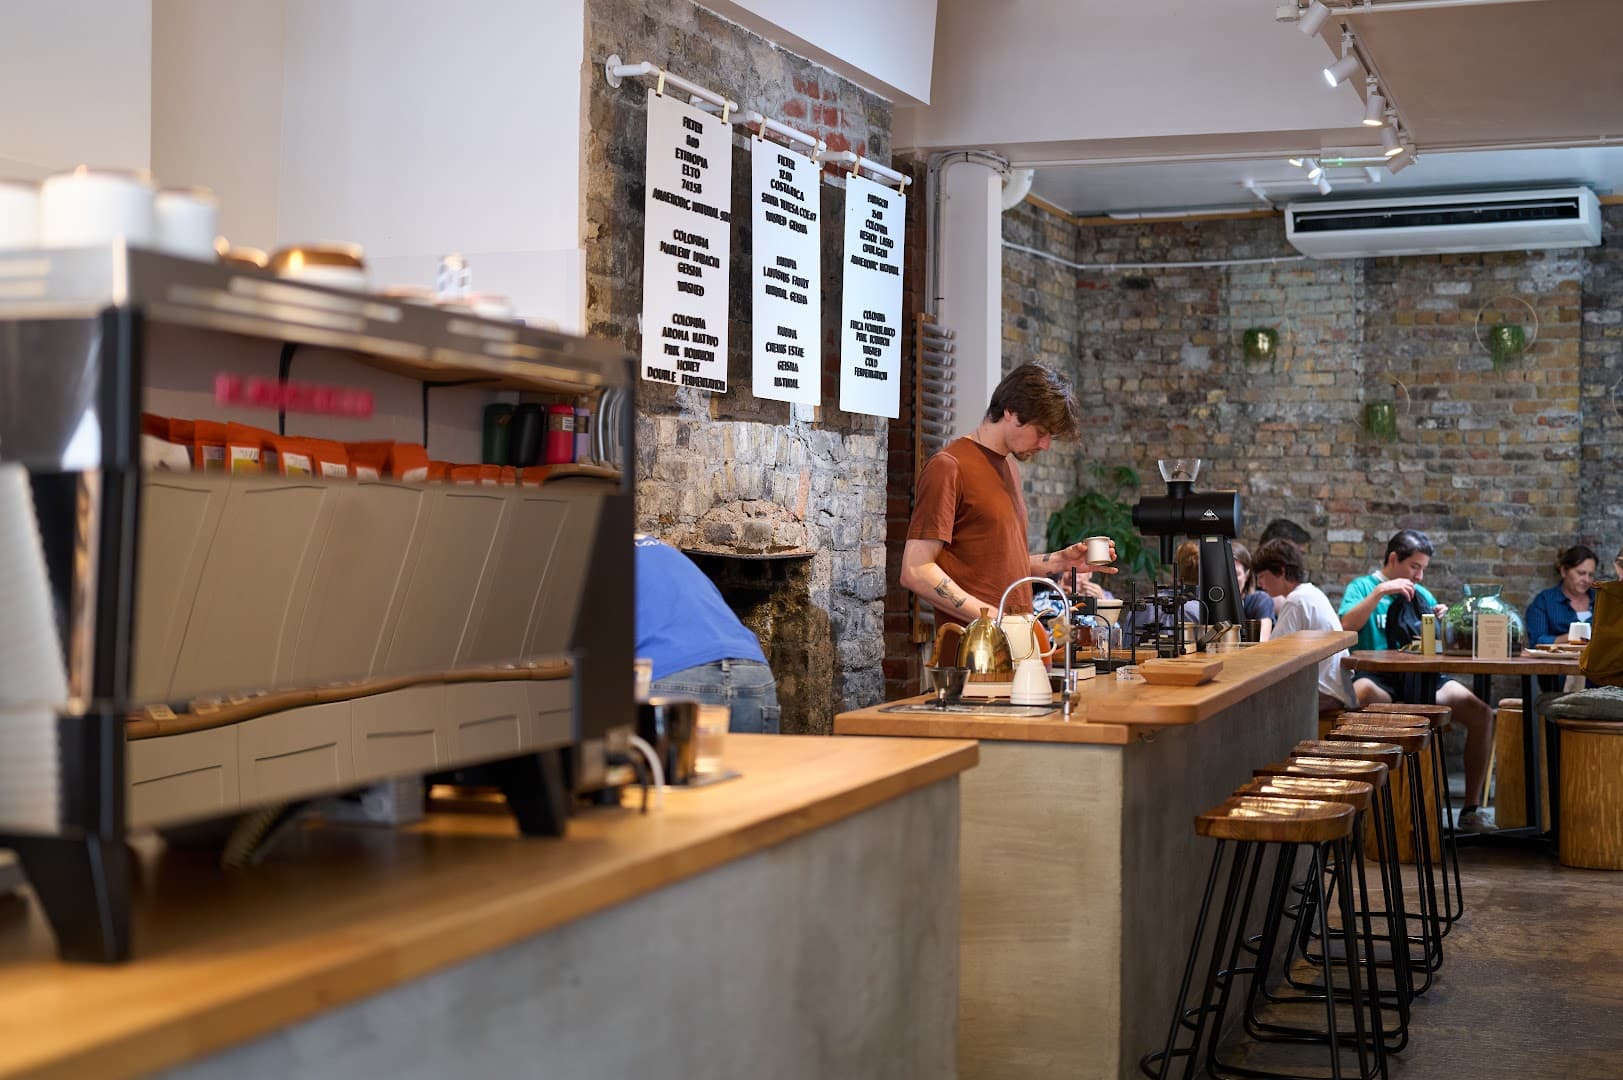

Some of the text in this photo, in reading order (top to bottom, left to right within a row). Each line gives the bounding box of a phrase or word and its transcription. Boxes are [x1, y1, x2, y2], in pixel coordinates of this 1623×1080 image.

[683, 116, 703, 134] FILTER
[675, 147, 708, 169] ETHIOPIA
[778, 154, 795, 170] FILTER
[682, 163, 700, 179] ELTO
[652, 188, 691, 210] ANAEROBIC
[692, 201, 720, 219] NATURAL
[766, 211, 808, 234] WASHED GEISHA
[866, 219, 887, 235] COLOMBIA
[673, 229, 709, 249] COLOMBIA
[677, 262, 702, 278] GEISHA
[677, 281, 704, 296] WASHED
[672, 313, 706, 329] COLOMBIA
[863, 310, 885, 322] COLOMBIA
[662, 326, 719, 347] AROMA NATIVO
[664, 343, 714, 362] PINK BOURBON
[677, 359, 700, 372] HONEY
[777, 360, 799, 372] GEISHA
[647, 366, 677, 382] DOUBLE
[774, 377, 800, 389] NATURAL
